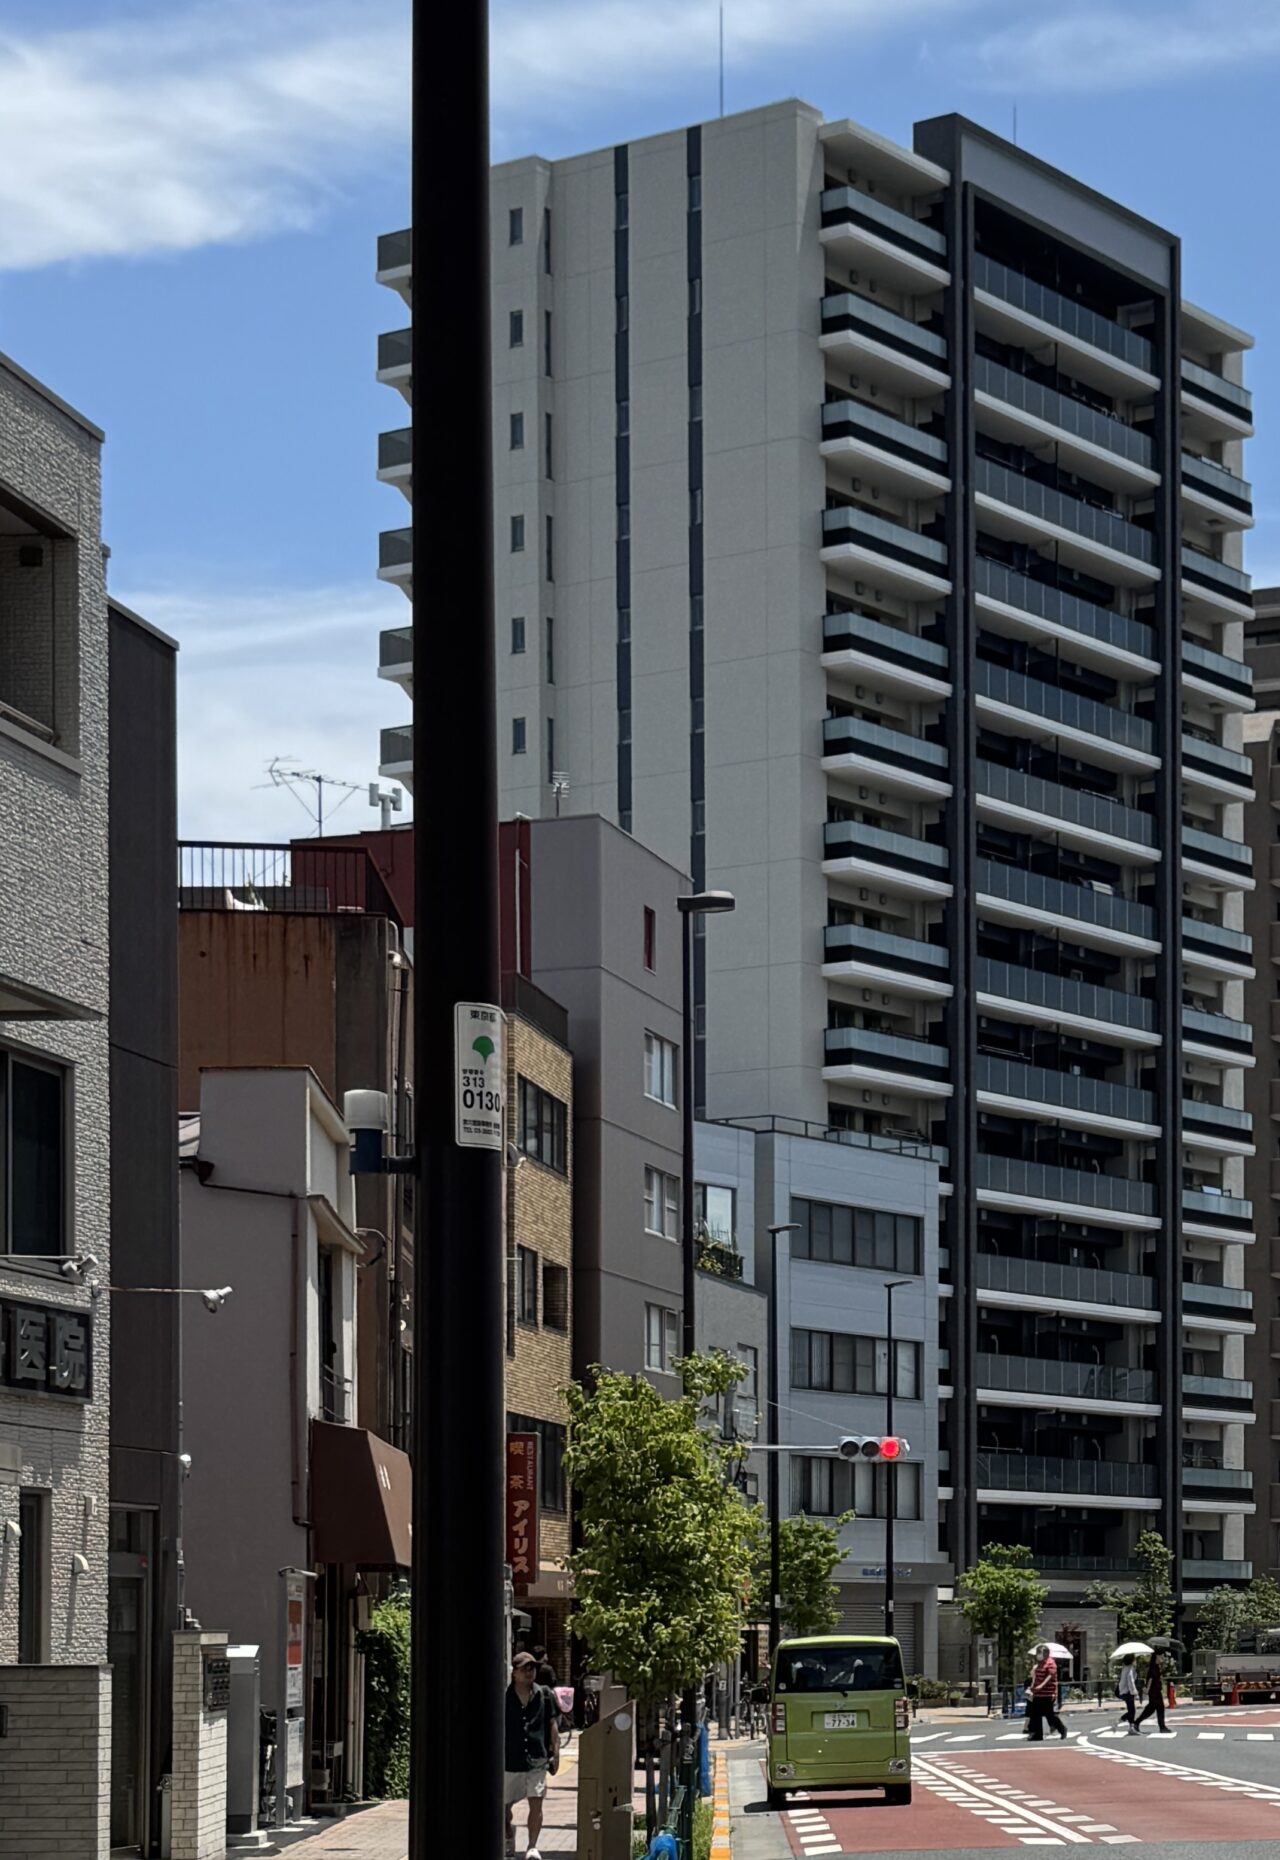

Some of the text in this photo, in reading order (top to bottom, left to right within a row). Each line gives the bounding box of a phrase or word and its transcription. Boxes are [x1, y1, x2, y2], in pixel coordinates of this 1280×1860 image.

[463, 1076, 485, 1088] 313
[463, 1089, 500, 1112] 0130
[0, 1304, 85, 1389] 医院
[509, 1441, 525, 1490] 喫茶
[511, 1500, 530, 1573] アイリス
